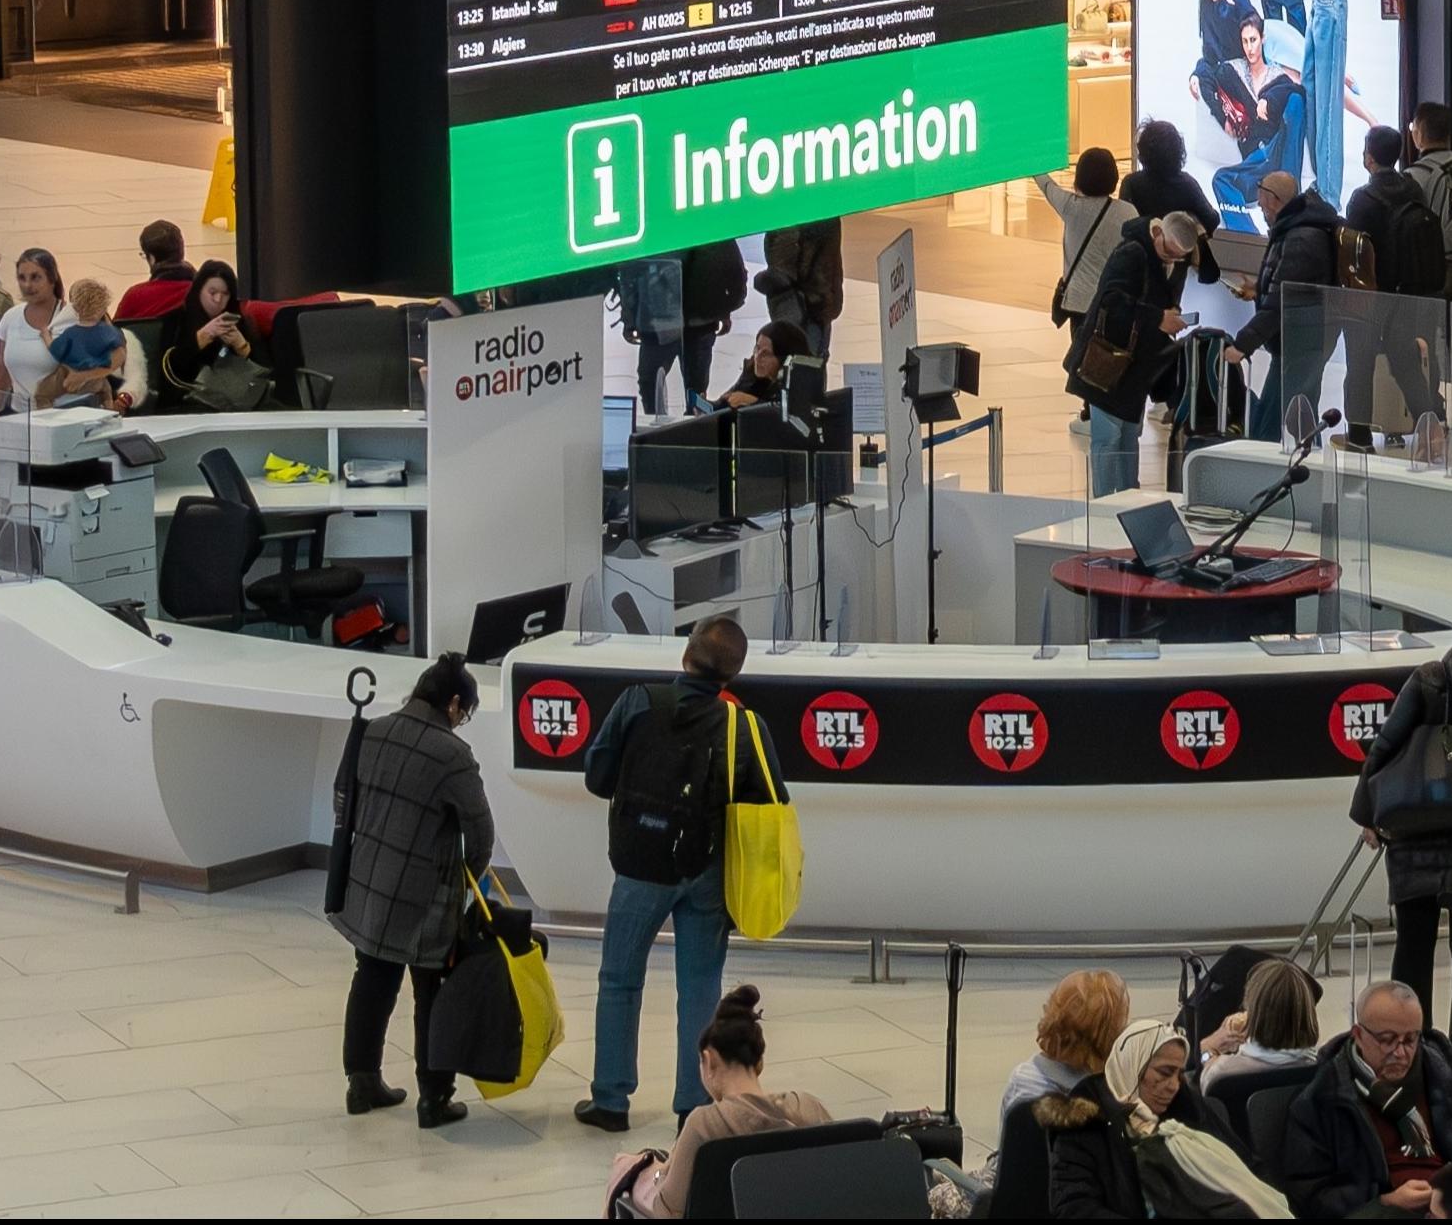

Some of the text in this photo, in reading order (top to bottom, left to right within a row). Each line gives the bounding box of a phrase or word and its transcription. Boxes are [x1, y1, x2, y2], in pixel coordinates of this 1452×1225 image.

[457, 41, 484, 59] 13:30
[491, 36, 525, 56] Algiers
[641, 15, 656, 31] AH
[718, 4, 728, 18] le
[728, 0, 752, 17] 12:15
[613, 5, 934, 69] Se il tuo gate non è ancora disponibile, recati nell'area indicata su questo monitor
[615, 82, 631, 98] per
[632, 77, 638, 92] il
[639, 78, 655, 91] tuo
[655, 72, 677, 88] volo:
[691, 69, 707, 85] per
[707, 58, 757, 80] destinazioni
[758, 54, 799, 72] Schengen;
[814, 49, 829, 64] per
[829, 38, 876, 59] destinazioni
[877, 36, 897, 51] extra
[898, 31, 935, 48] Schengen
[674, 88, 977, 210] Information
[475, 325, 545, 365] radio
[533, 699, 577, 722] RTL
[1344, 704, 1388, 726] RTL
[533, 720, 577, 736] 102.5
[817, 712, 864, 733] RTL
[985, 714, 1033, 735] RTL
[1177, 711, 1224, 734] RTL
[1345, 724, 1378, 740] 102.
[817, 734, 865, 747] 102.5
[985, 737, 1034, 749] 102.5
[1177, 733, 1225, 747] 102.5
